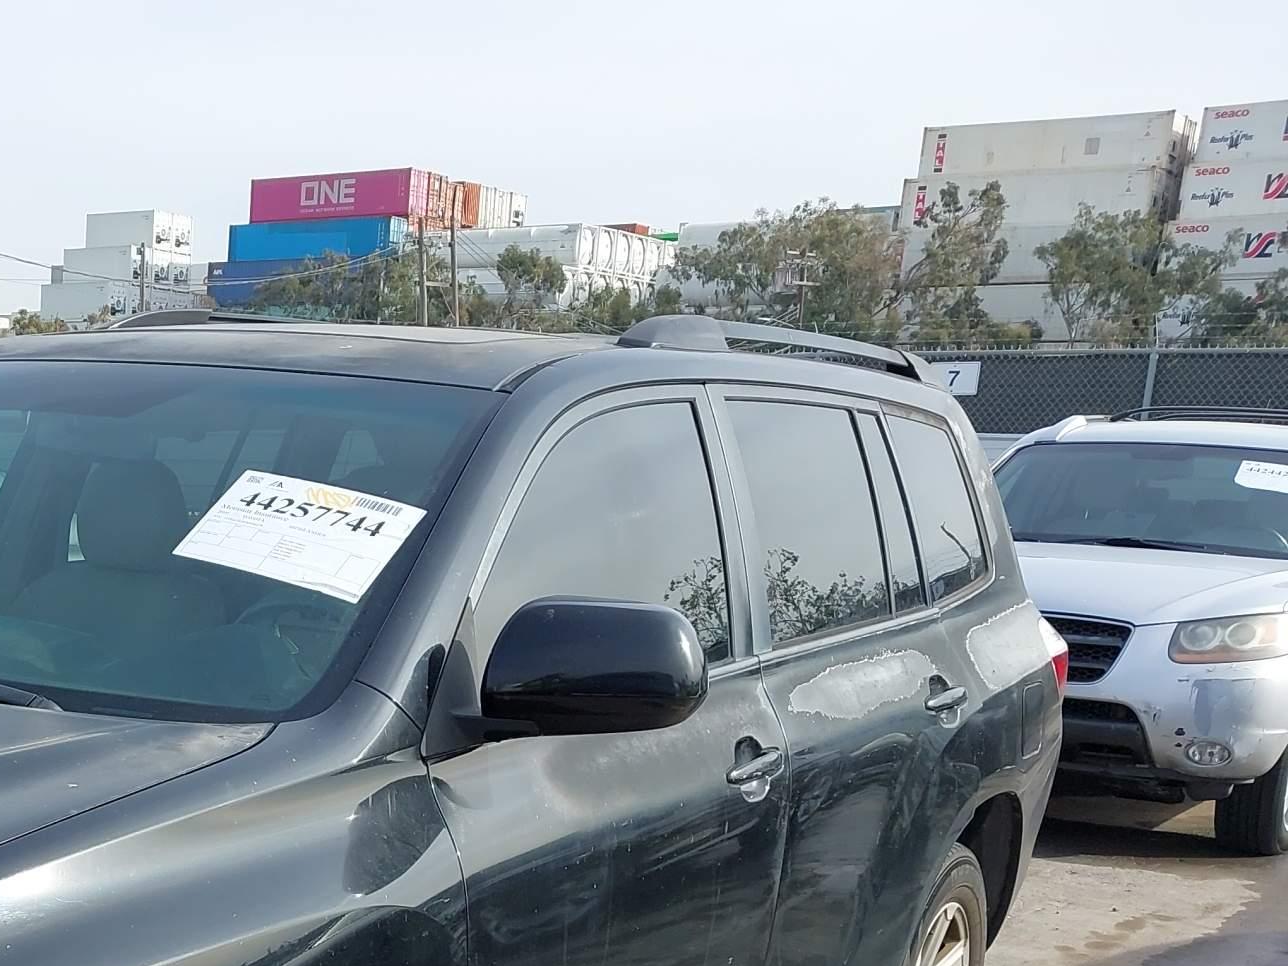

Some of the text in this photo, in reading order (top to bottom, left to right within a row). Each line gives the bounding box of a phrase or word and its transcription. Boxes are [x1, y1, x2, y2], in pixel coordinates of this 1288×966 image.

[1214, 109, 1250, 119] seaco
[1195, 166, 1230, 176] seaco
[300, 178, 356, 206] ONE
[1175, 224, 1209, 234] seaco
[948, 370, 961, 387] 7
[239, 491, 386, 537] 44257744
